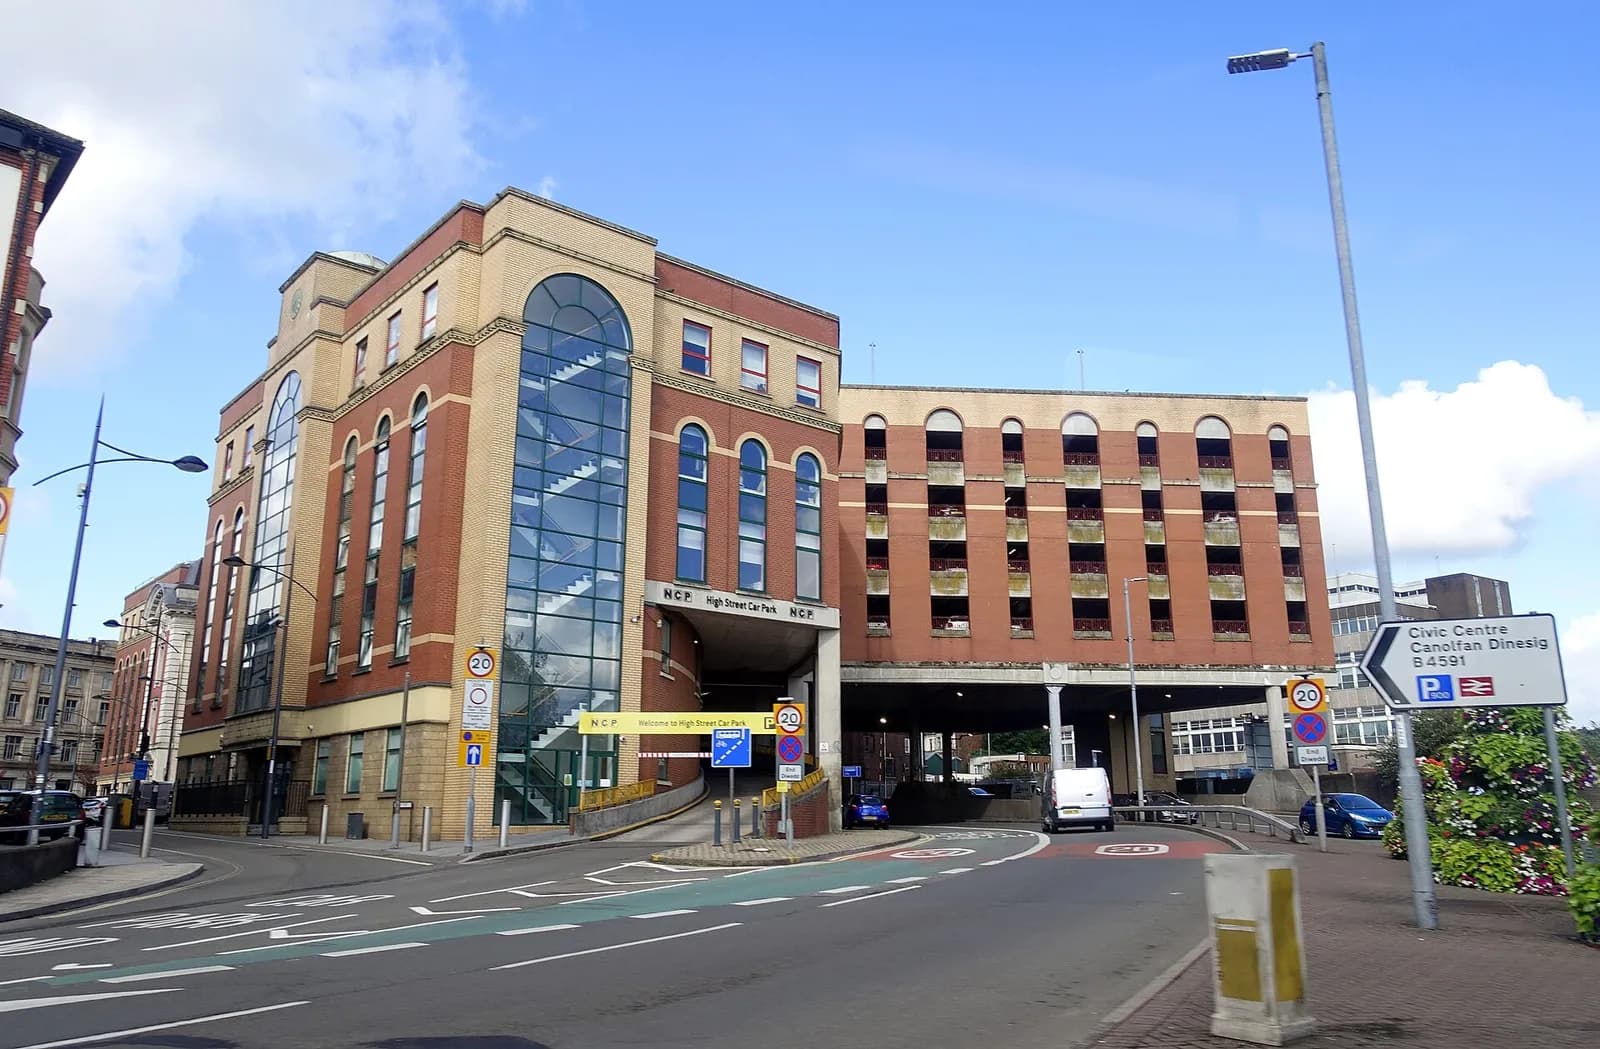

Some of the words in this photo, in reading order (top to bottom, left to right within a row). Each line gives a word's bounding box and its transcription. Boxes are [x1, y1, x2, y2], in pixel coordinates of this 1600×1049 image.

[664, 588, 692, 602] NCP
[706, 595, 724, 608] High
[724, 598, 747, 611] Street
[748, 601, 760, 612] Car
[761, 604, 777, 614] Park
[789, 606, 814, 619] NCP
[1409, 626, 1447, 639] Civic
[1453, 624, 1508, 637] Centre
[1410, 639, 1482, 654] Canolfan
[1489, 636, 1549, 651] Dinesig
[471, 657, 491, 669] 20
[1297, 689, 1318, 701] 20
[1420, 677, 1440, 700] P
[591, 719, 617, 727] NCP
[638, 718, 668, 727] Welcome
[670, 719, 677, 727] to
[678, 718, 695, 729] High
[696, 718, 716, 727] Street
[718, 718, 730, 727] Car
[731, 718, 746, 727] Park
[780, 713, 799, 724] 20
